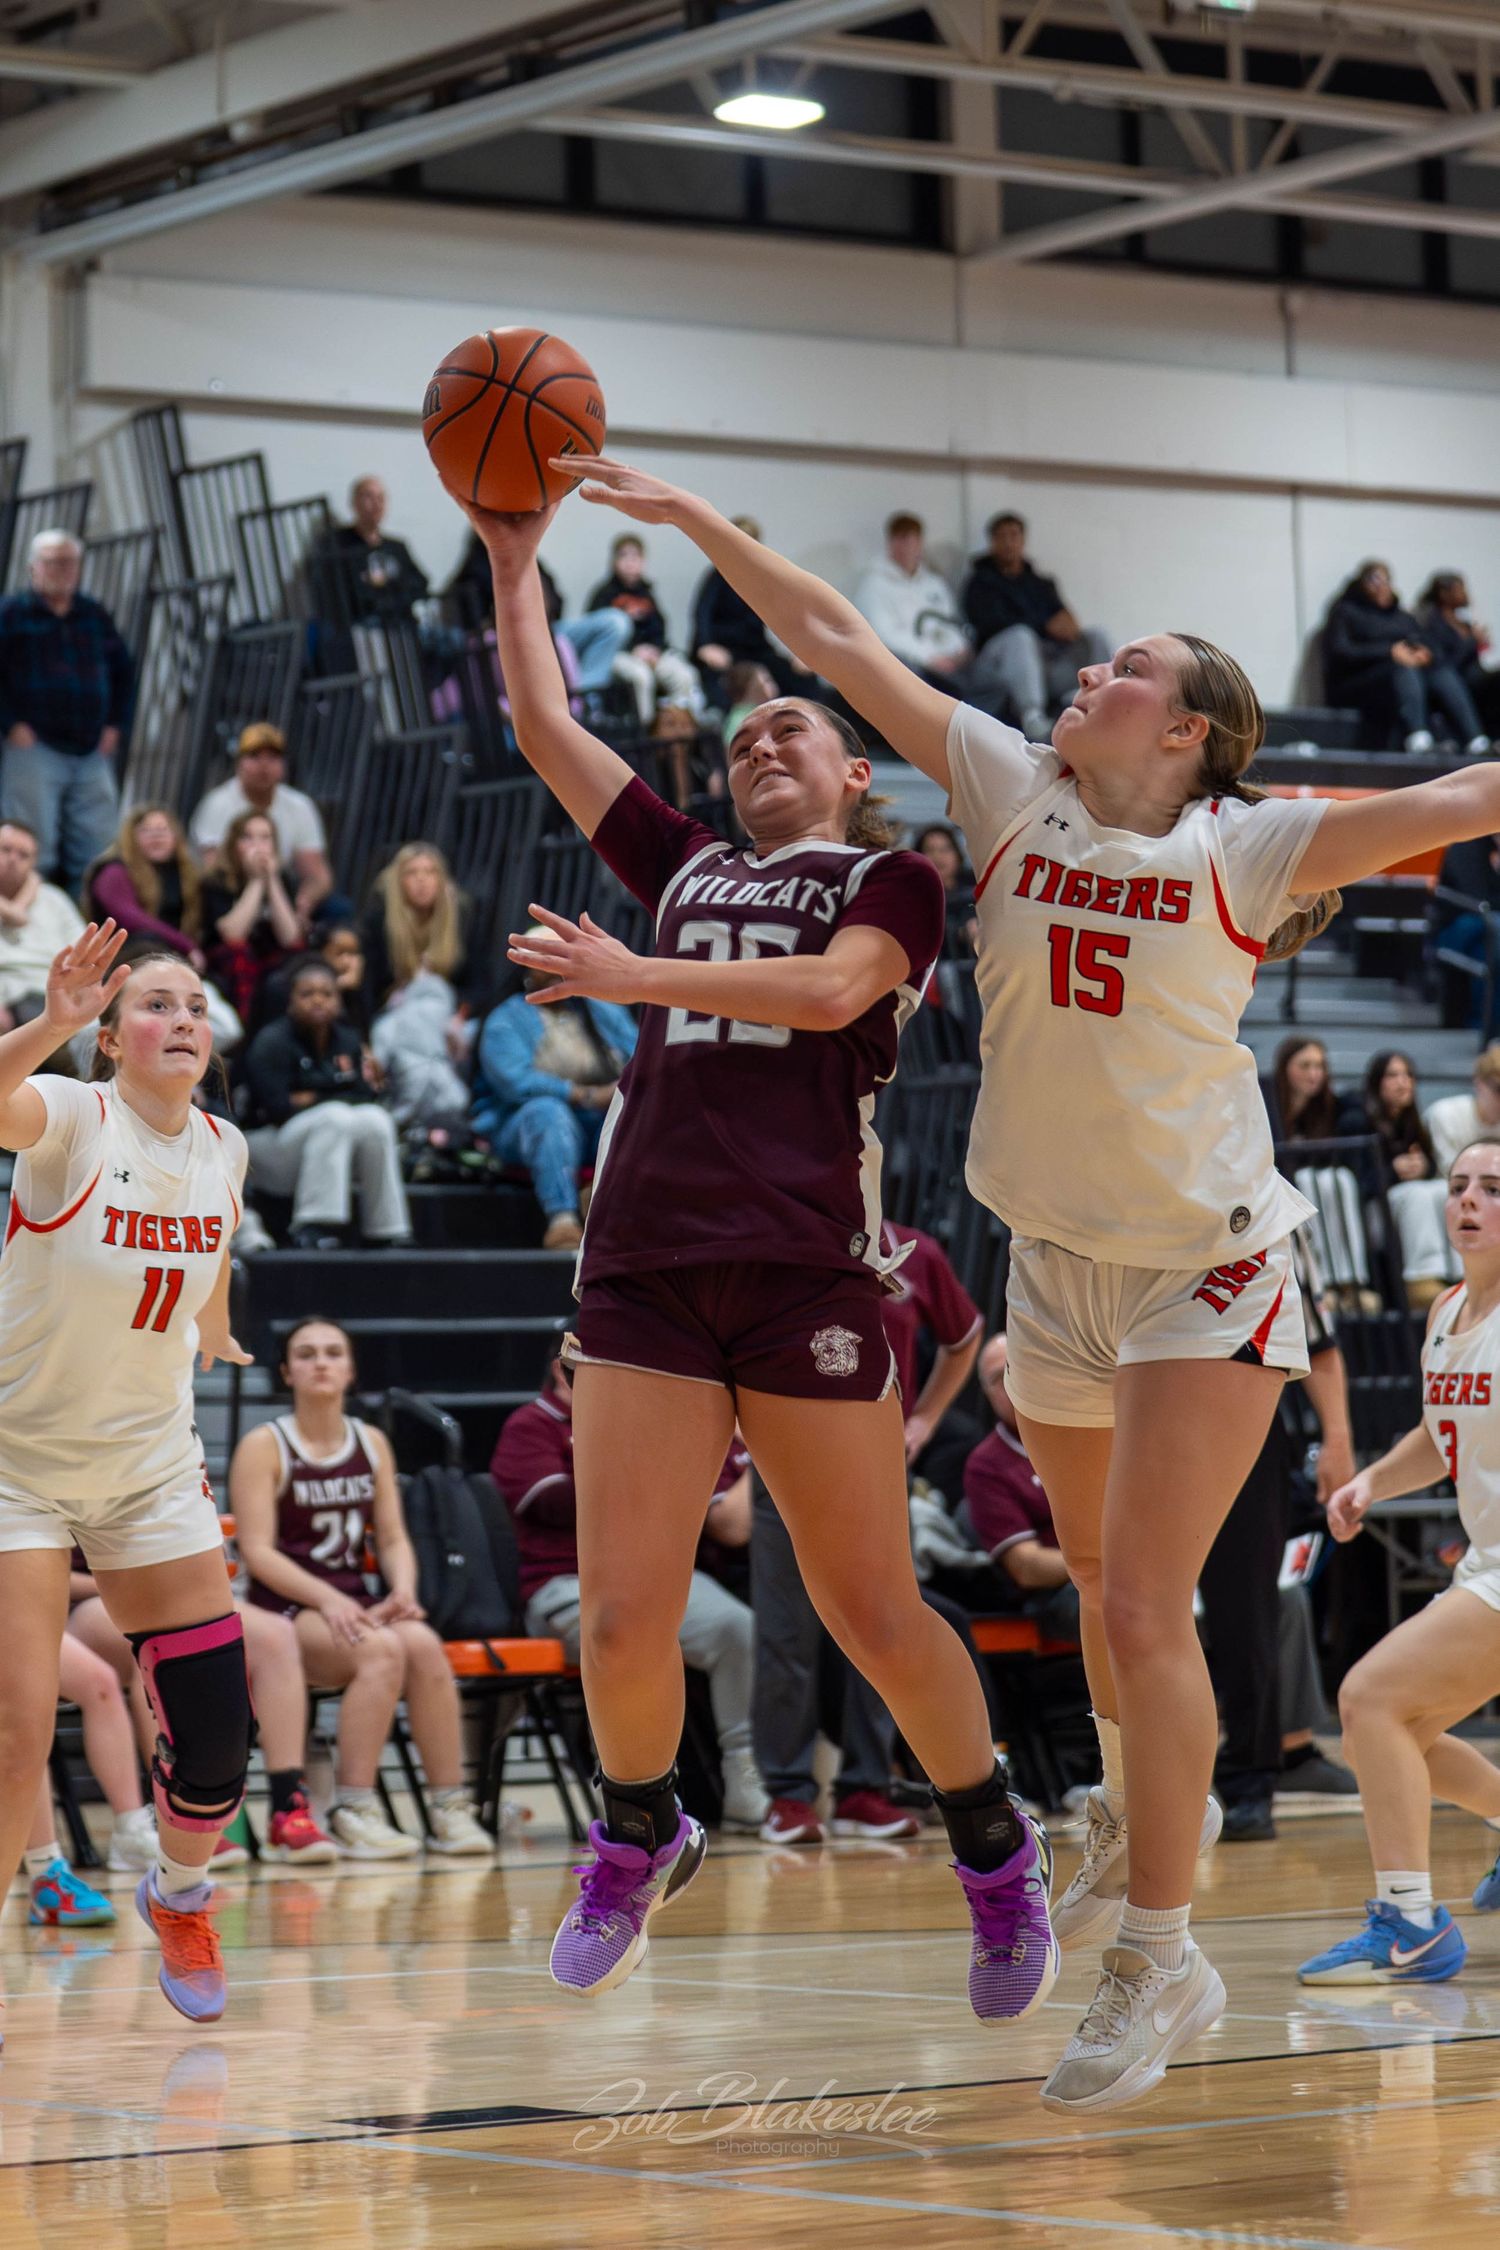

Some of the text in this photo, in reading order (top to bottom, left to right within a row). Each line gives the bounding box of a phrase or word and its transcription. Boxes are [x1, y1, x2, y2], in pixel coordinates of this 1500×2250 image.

[675, 873, 842, 925] WILDCATS
[1013, 853, 1193, 924] TIGERS
[1047, 923, 1131, 1017] 15
[101, 1205, 223, 1253] TIGERS
[130, 1266, 185, 1333] 11
[1437, 1419, 1458, 1484] 3
